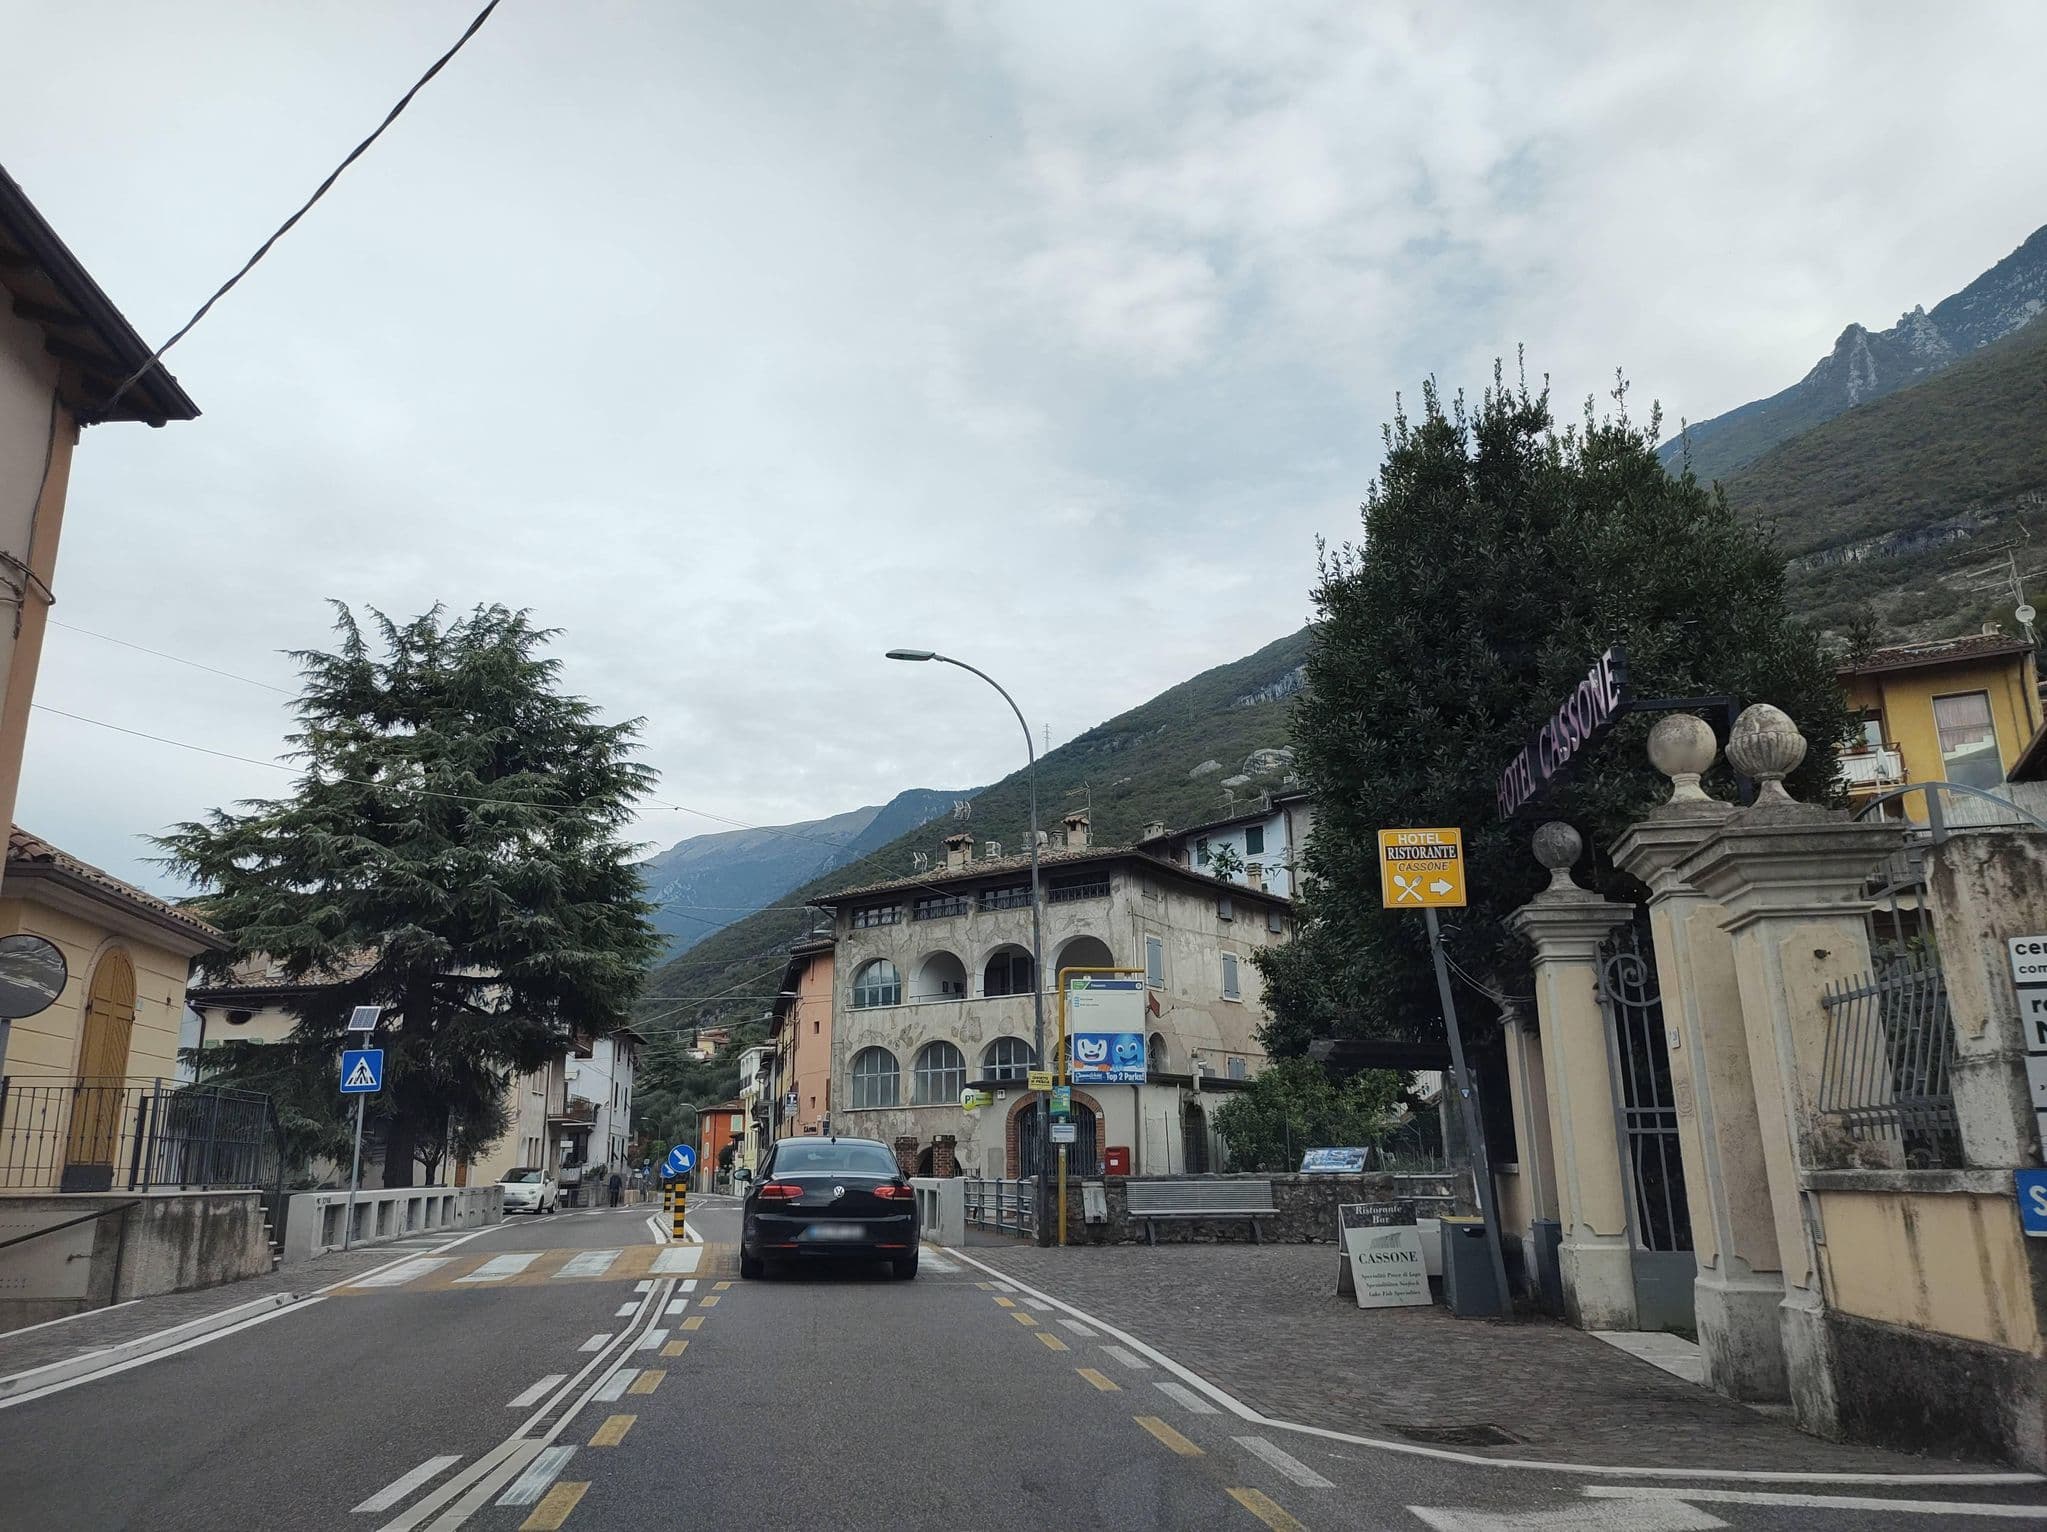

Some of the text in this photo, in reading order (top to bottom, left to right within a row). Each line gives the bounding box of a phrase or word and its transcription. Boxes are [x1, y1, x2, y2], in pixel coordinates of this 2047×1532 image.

[1496, 648, 1619, 820] HOTEL CASSONE
[1398, 833, 1444, 845] HOTEL
[1387, 846, 1457, 860] RISTORANTE
[1106, 1072, 1118, 1083] Top
[1119, 1072, 1124, 1081] 2
[1124, 1072, 1145, 1081] Parks!
[1355, 1205, 1402, 1215] Ristorante
[1372, 1215, 1390, 1224] Bar
[1358, 1250, 1418, 1265] CASSONE
